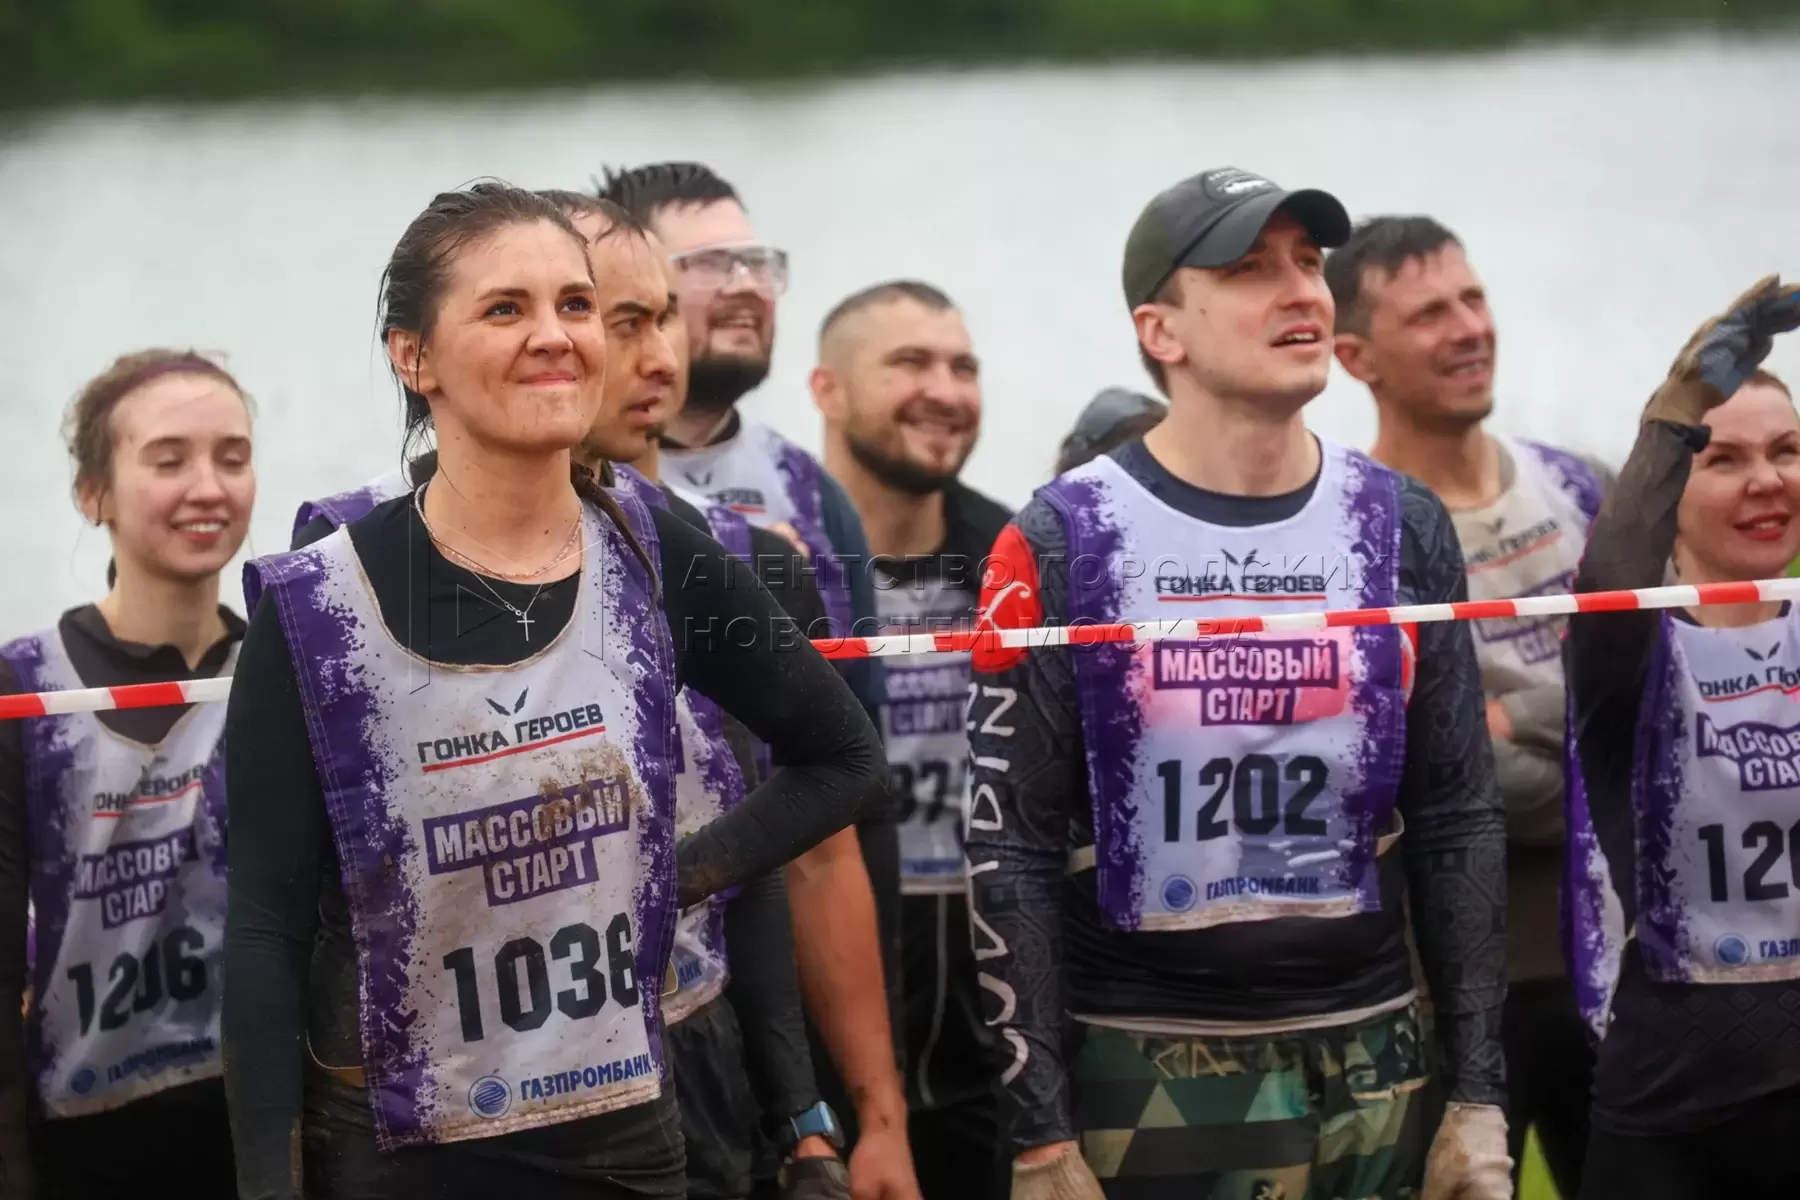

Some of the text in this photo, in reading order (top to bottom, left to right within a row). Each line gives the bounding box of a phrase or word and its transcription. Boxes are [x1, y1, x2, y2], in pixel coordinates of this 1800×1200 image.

[1155, 574, 1326, 593] ГОНКА ГЕРОЕВ
[1161, 640, 1333, 682] МАССОВЫЙ
[1693, 673, 1760, 696] ОНКА
[1206, 688, 1290, 721] СТАРТ
[417, 703, 604, 764] ГОНКА ГЕРОЕВ
[433, 775, 624, 864] МАССОВЫЙ
[1157, 753, 1329, 842] 1202
[491, 840, 587, 899] СТАРТ
[104, 878, 170, 923] СТАР
[443, 912, 640, 1042] 1036
[520, 1052, 652, 1100] ГАЗПРОМБАНК
